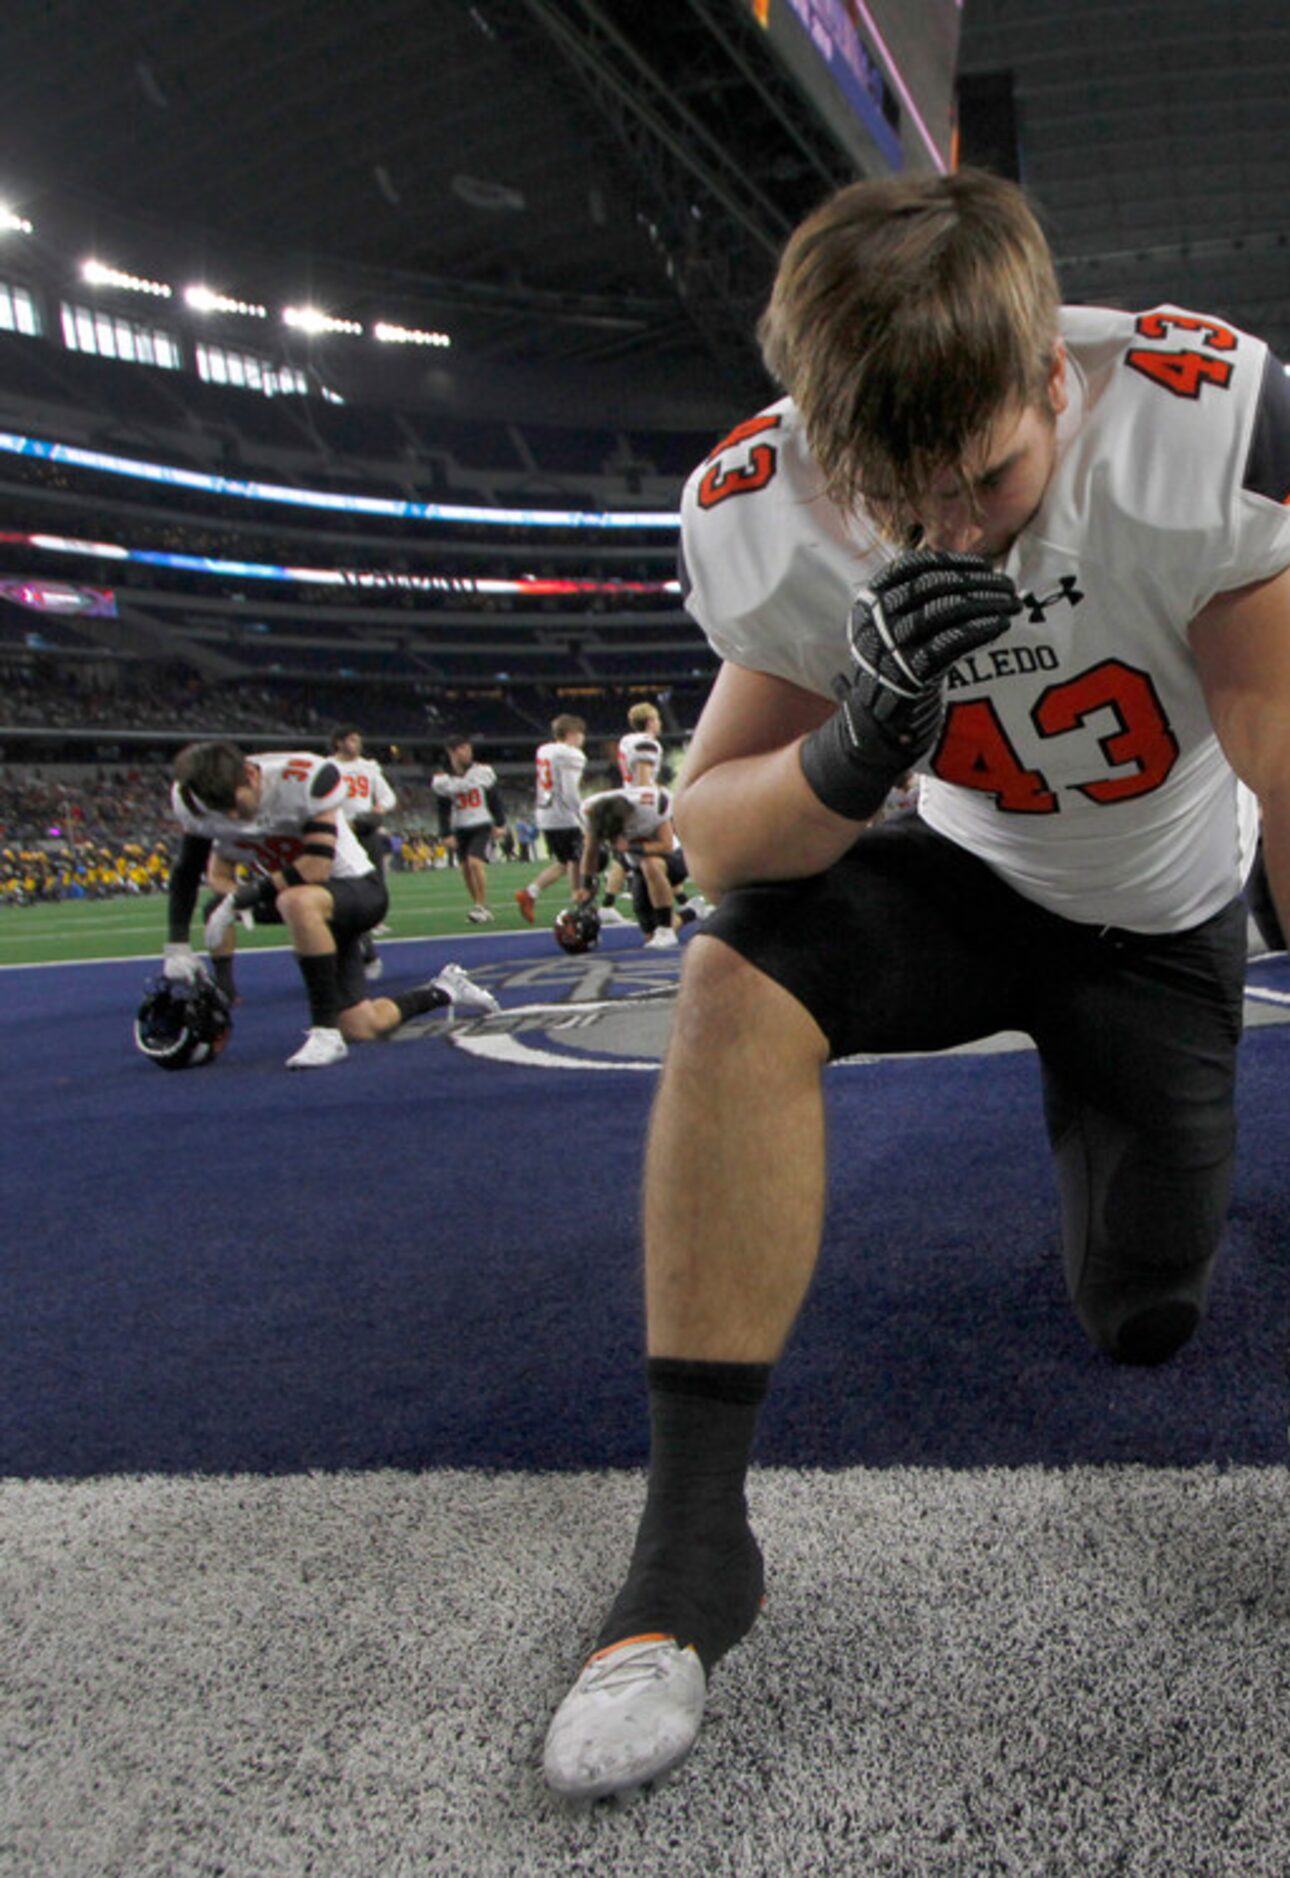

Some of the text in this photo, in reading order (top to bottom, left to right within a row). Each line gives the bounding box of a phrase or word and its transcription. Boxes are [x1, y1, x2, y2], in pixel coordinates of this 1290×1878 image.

[1123, 312, 1238, 400] 43
[947, 645, 1060, 690] ALEDO
[930, 657, 1181, 815] 43
